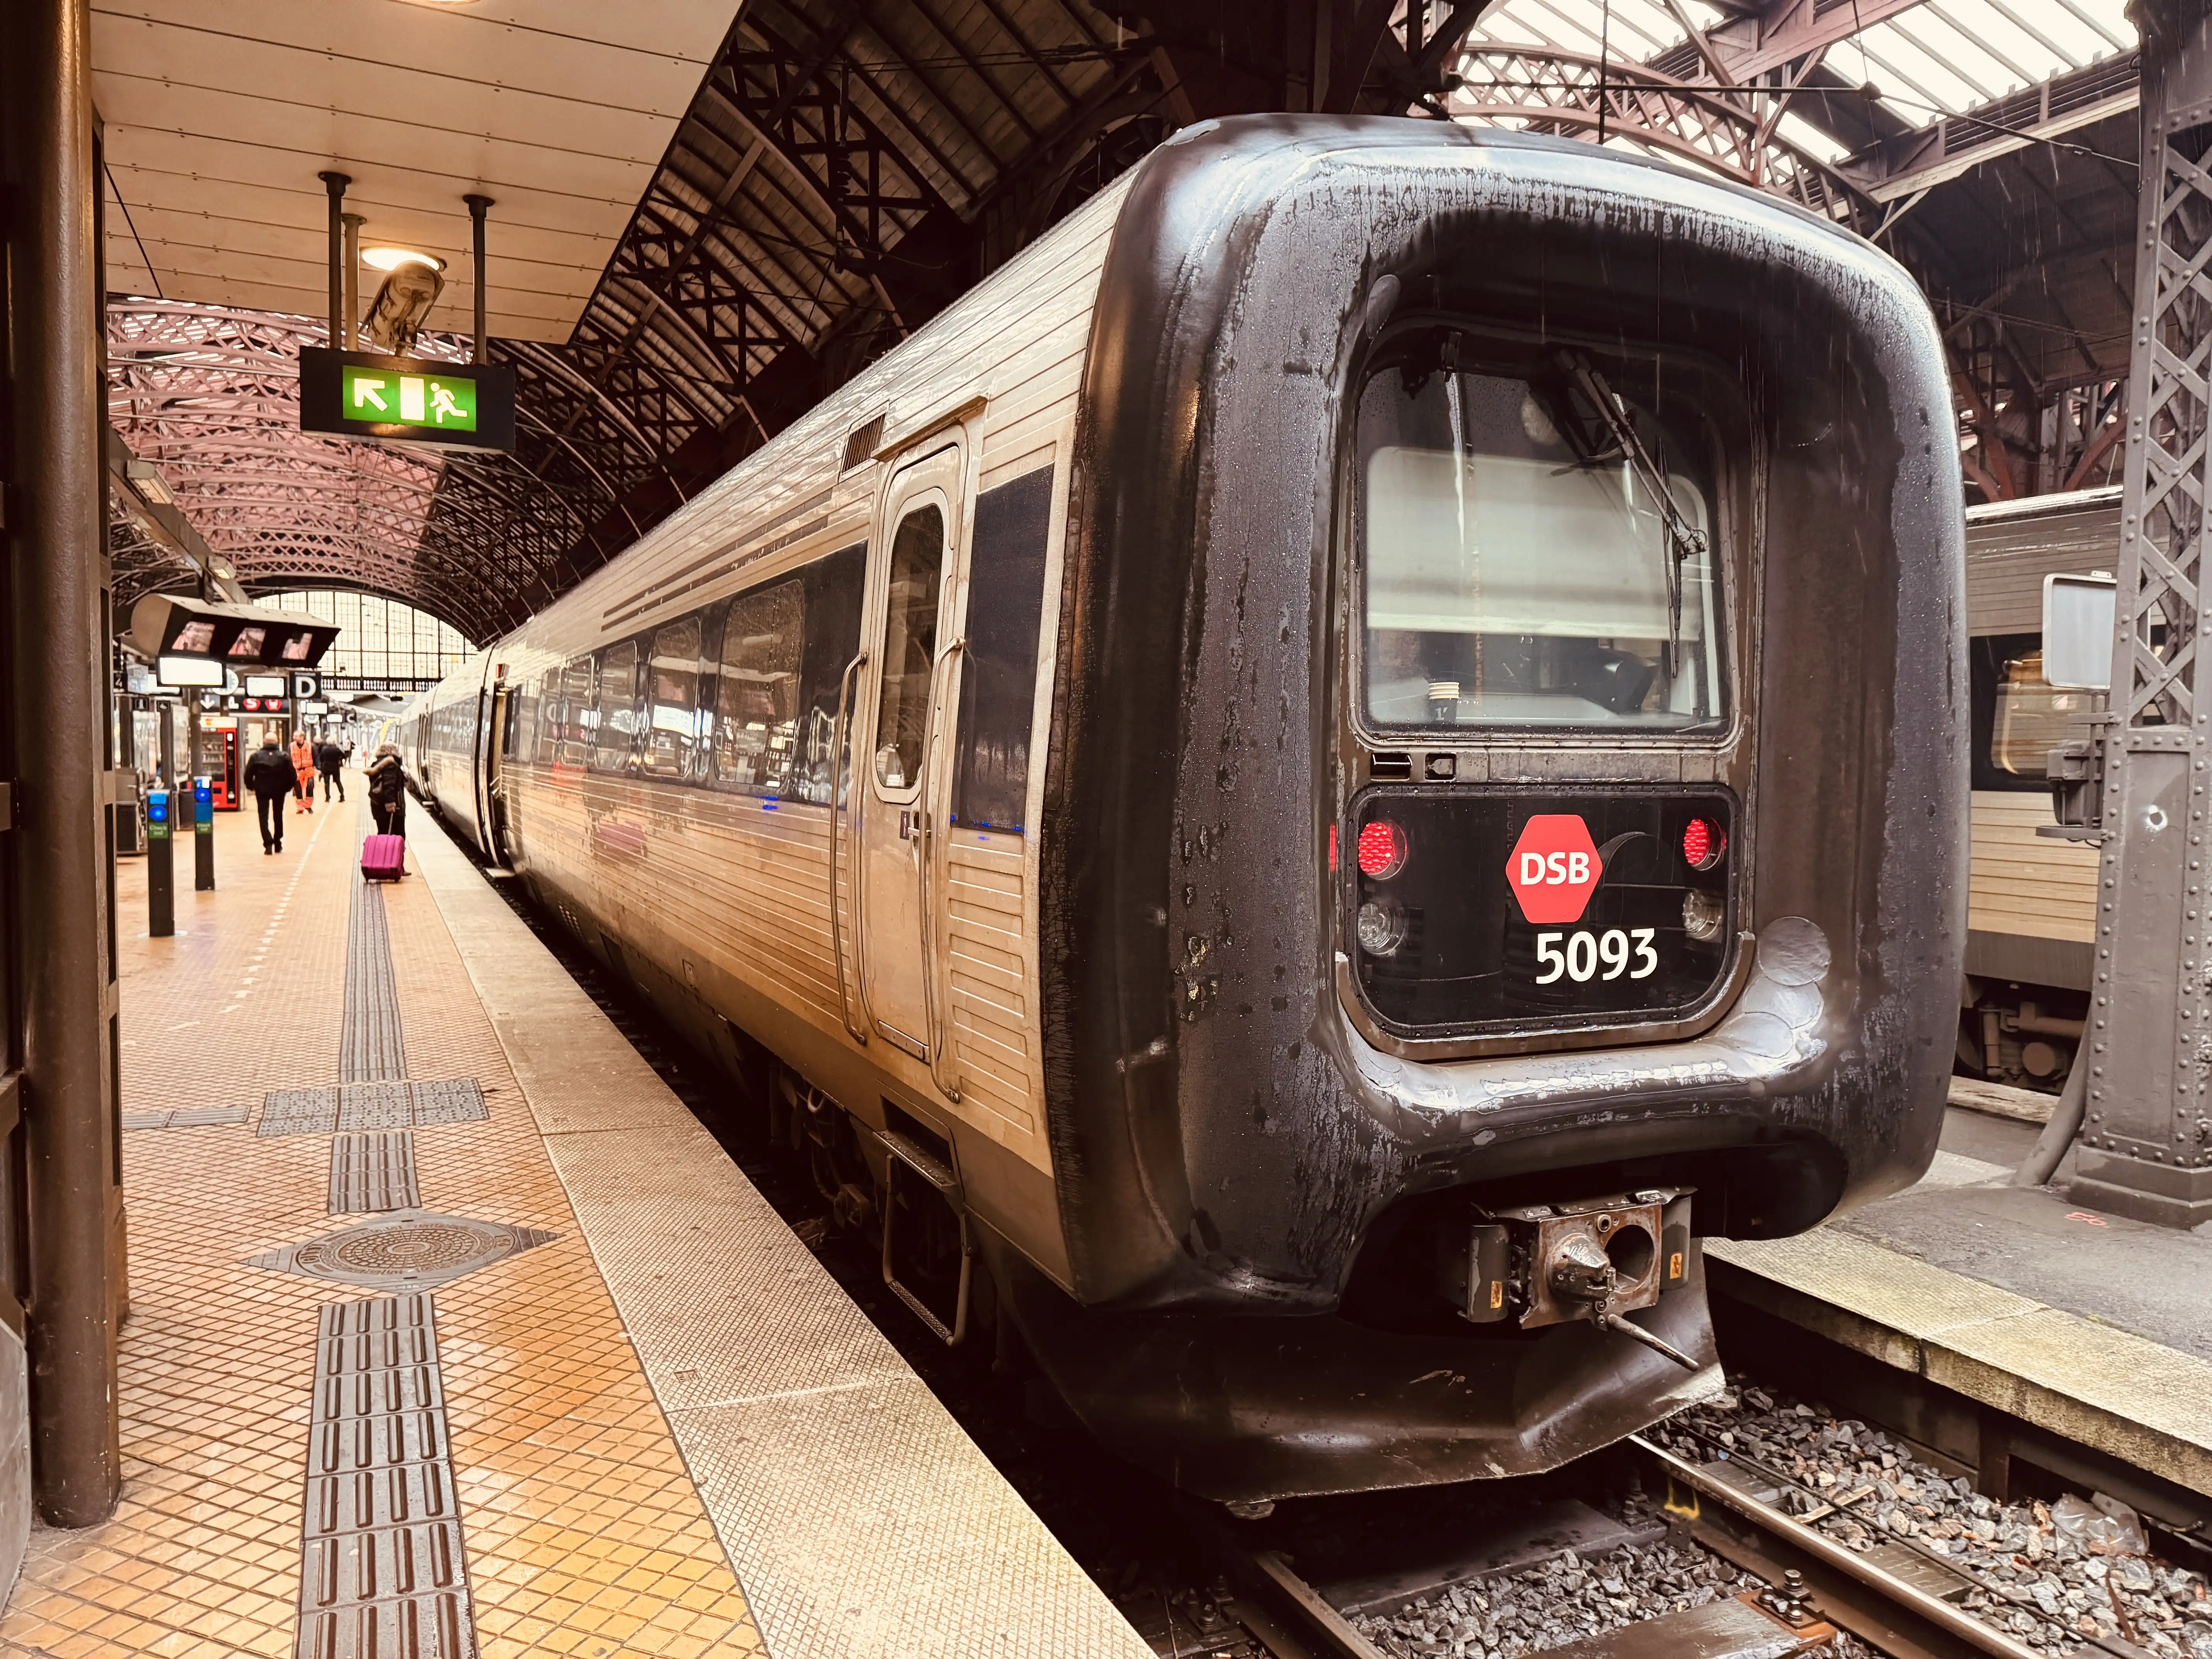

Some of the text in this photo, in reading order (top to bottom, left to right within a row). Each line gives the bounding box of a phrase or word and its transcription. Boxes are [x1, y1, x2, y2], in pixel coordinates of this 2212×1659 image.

[295, 676, 316, 697] D
[346, 713, 355, 723] C
[1520, 852, 1590, 885] DSB
[1536, 928, 1658, 984] 5093
